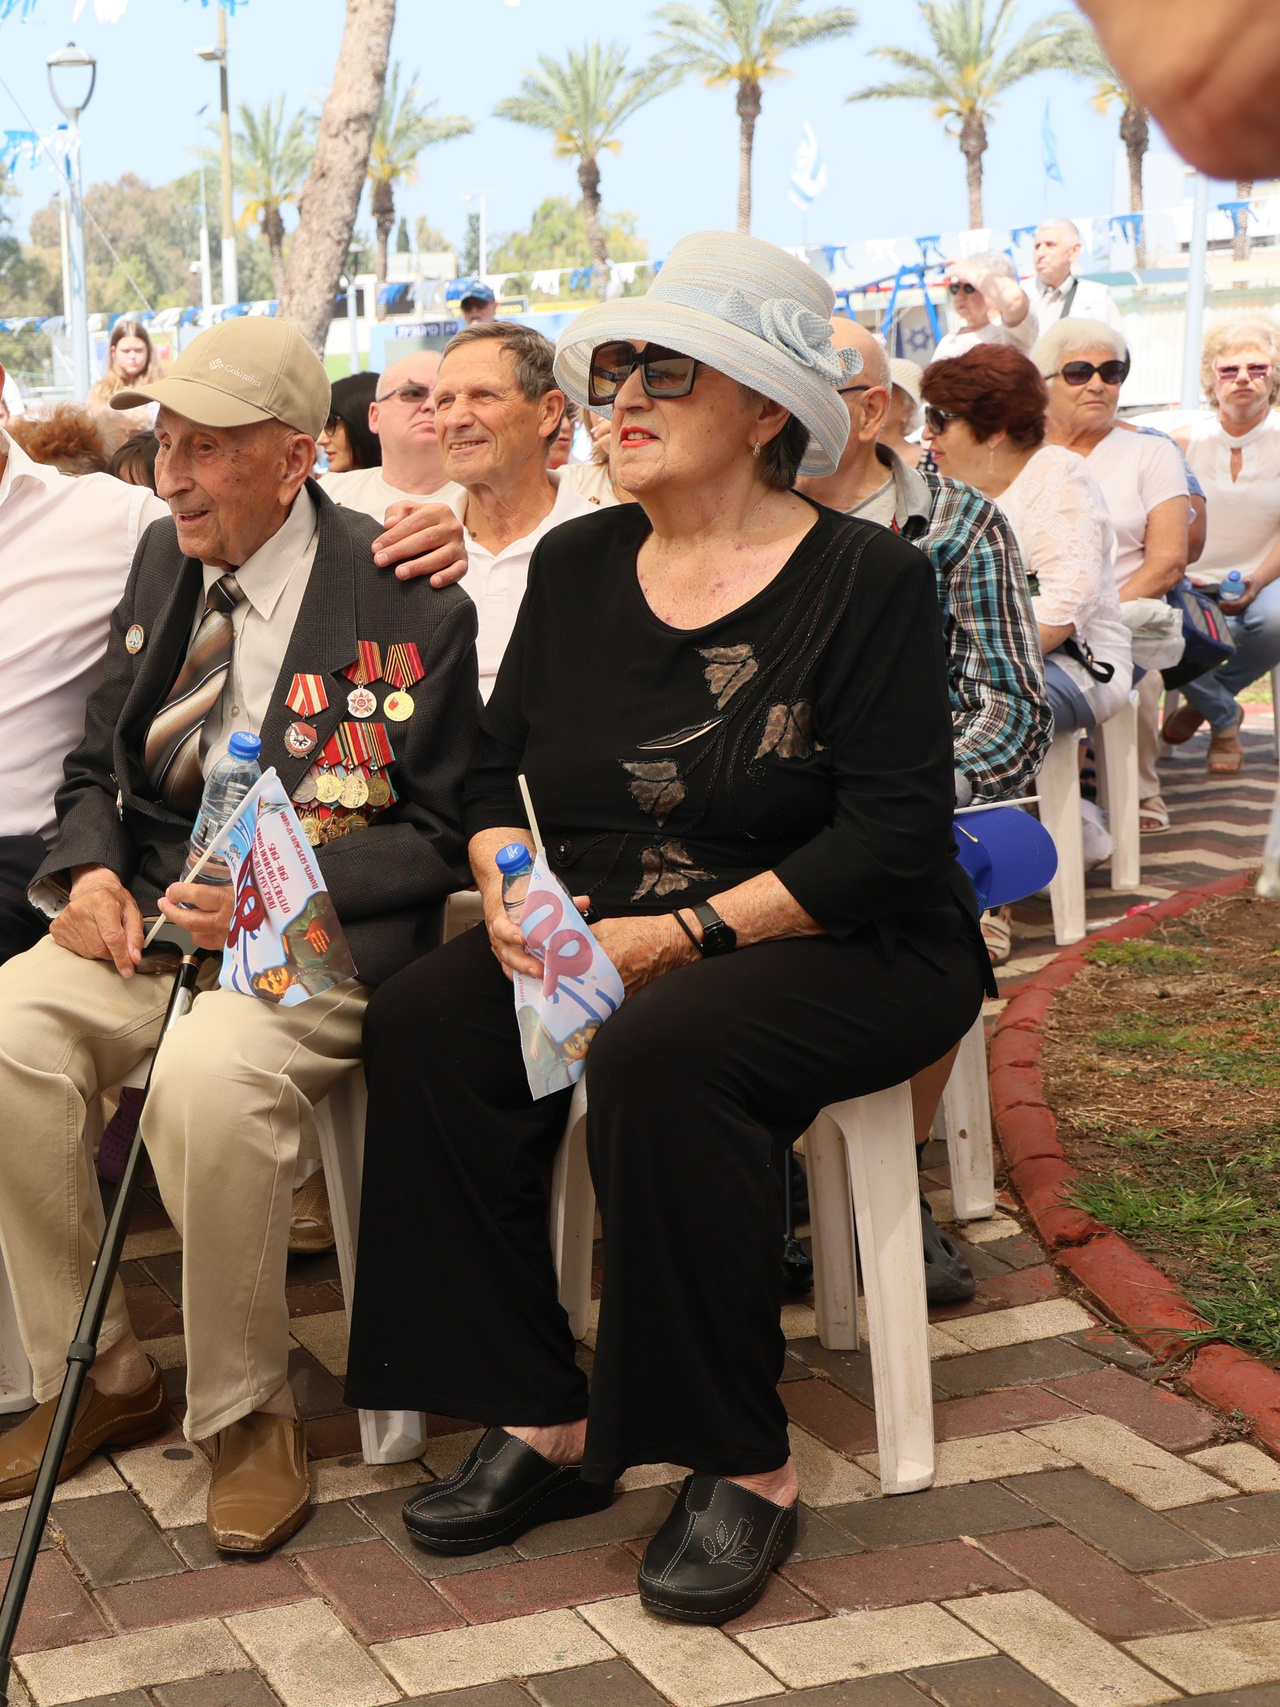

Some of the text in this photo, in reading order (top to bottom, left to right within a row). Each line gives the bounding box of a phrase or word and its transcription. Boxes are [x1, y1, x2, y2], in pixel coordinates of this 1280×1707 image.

[224, 364, 261, 388] Columbia
[280, 811, 319, 890] ПАМЯТЬ БЕРЕЖНО ХРАНИМ
[259, 876, 277, 910] ПОБЕДЫ
[260, 849, 291, 914] ОТЕЧЕСТВЕННОЙ
